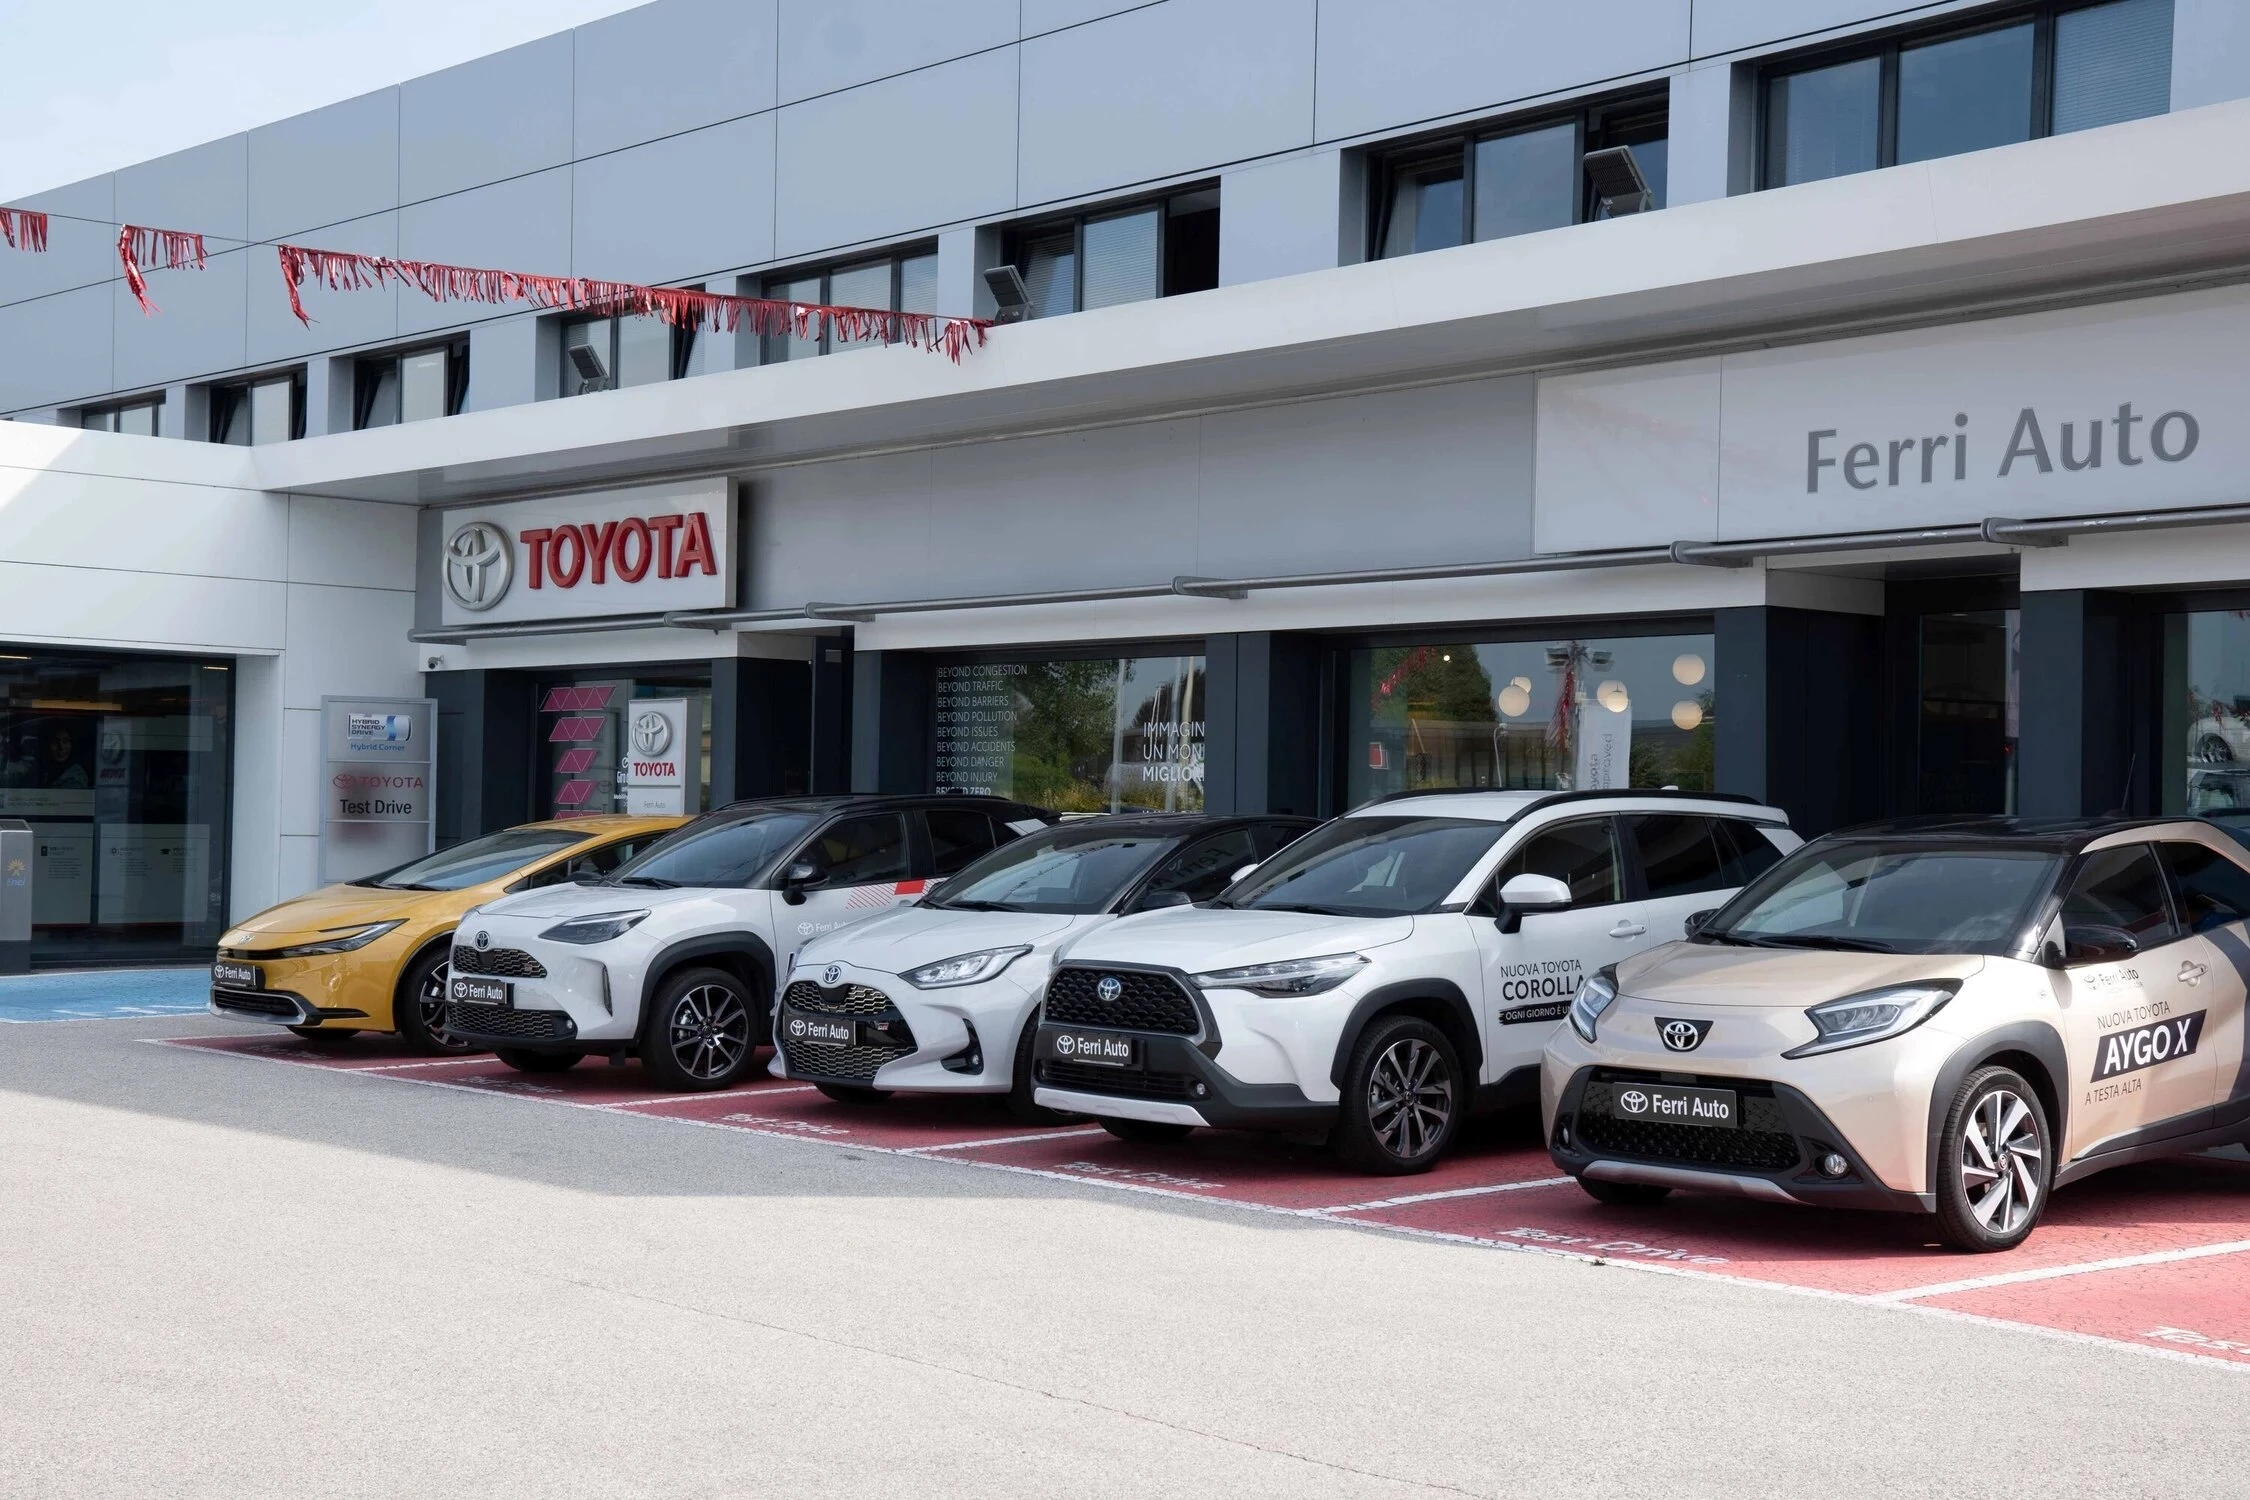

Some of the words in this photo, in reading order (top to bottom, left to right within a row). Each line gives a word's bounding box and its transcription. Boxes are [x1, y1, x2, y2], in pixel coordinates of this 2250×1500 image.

[1807, 412, 1968, 494] Ferri
[1997, 401, 2200, 478] Auto
[520, 512, 717, 589] TOYOTA
[938, 666, 970, 677] BEYOND
[972, 664, 1027, 677] CONGESTION
[938, 681, 970, 692] BEYOND
[972, 680, 1003, 691] TRAFFIC
[937, 696, 970, 707] BEYOND
[972, 695, 1008, 707] BARRIERS
[937, 711, 969, 722] BEYOND
[971, 710, 1017, 722] POLLUTION
[937, 726, 969, 737] BEYOND
[971, 725, 998, 737] ISSUES
[1143, 721, 1204, 737] IMMAGIN
[350, 743, 377, 751] Hybrid
[378, 743, 405, 751] Corner
[936, 741, 969, 752] BEYOND
[970, 740, 1015, 752] ACCIDENTS
[1143, 743, 1163, 760] UN
[1168, 743, 1205, 760] MON
[936, 756, 968, 767] BEYOND
[970, 756, 1004, 767] DANGER
[633, 762, 676, 777] TOYOTA
[936, 771, 968, 782] BEYOND
[970, 771, 997, 782] INJURY
[359, 776, 423, 788] TOYOTA
[935, 786, 968, 795] BEYD
[970, 786, 991, 796] ZERO
[340, 799, 371, 814] Test
[375, 799, 412, 814] Drive
[7, 877, 26, 887] Enel
[815, 921, 832, 931] Ferri
[833, 920, 850, 929] Aut
[225, 966, 238, 979] Ferri
[238, 967, 251, 980] Auto
[1500, 963, 1540, 978] NUOVA
[1541, 959, 1582, 974] TOYOTA
[2119, 968, 2139, 983] Auto
[469, 984, 485, 998] Ferri
[487, 985, 503, 1000] Auto
[1505, 1010, 1525, 1020] OGNI
[1526, 1006, 1556, 1018] GIORNO
[2097, 1010, 2133, 1030] NUOVA
[2134, 1001, 2171, 1020] TOYOTA
[808, 1022, 827, 1037] Ferri
[829, 1024, 849, 1040] Auto
[1077, 1037, 1101, 1055] Ferri
[1103, 1039, 1129, 1057] Auto
[2103, 1025, 2171, 1075] AYGO
[2173, 1018, 2192, 1055] X
[2084, 1092, 2092, 1105] A
[2094, 1083, 2120, 1103] TESTA
[2121, 1078, 2142, 1096] ALTA
[1652, 1094, 1688, 1116] Ferri
[1692, 1097, 1729, 1119] Auto
